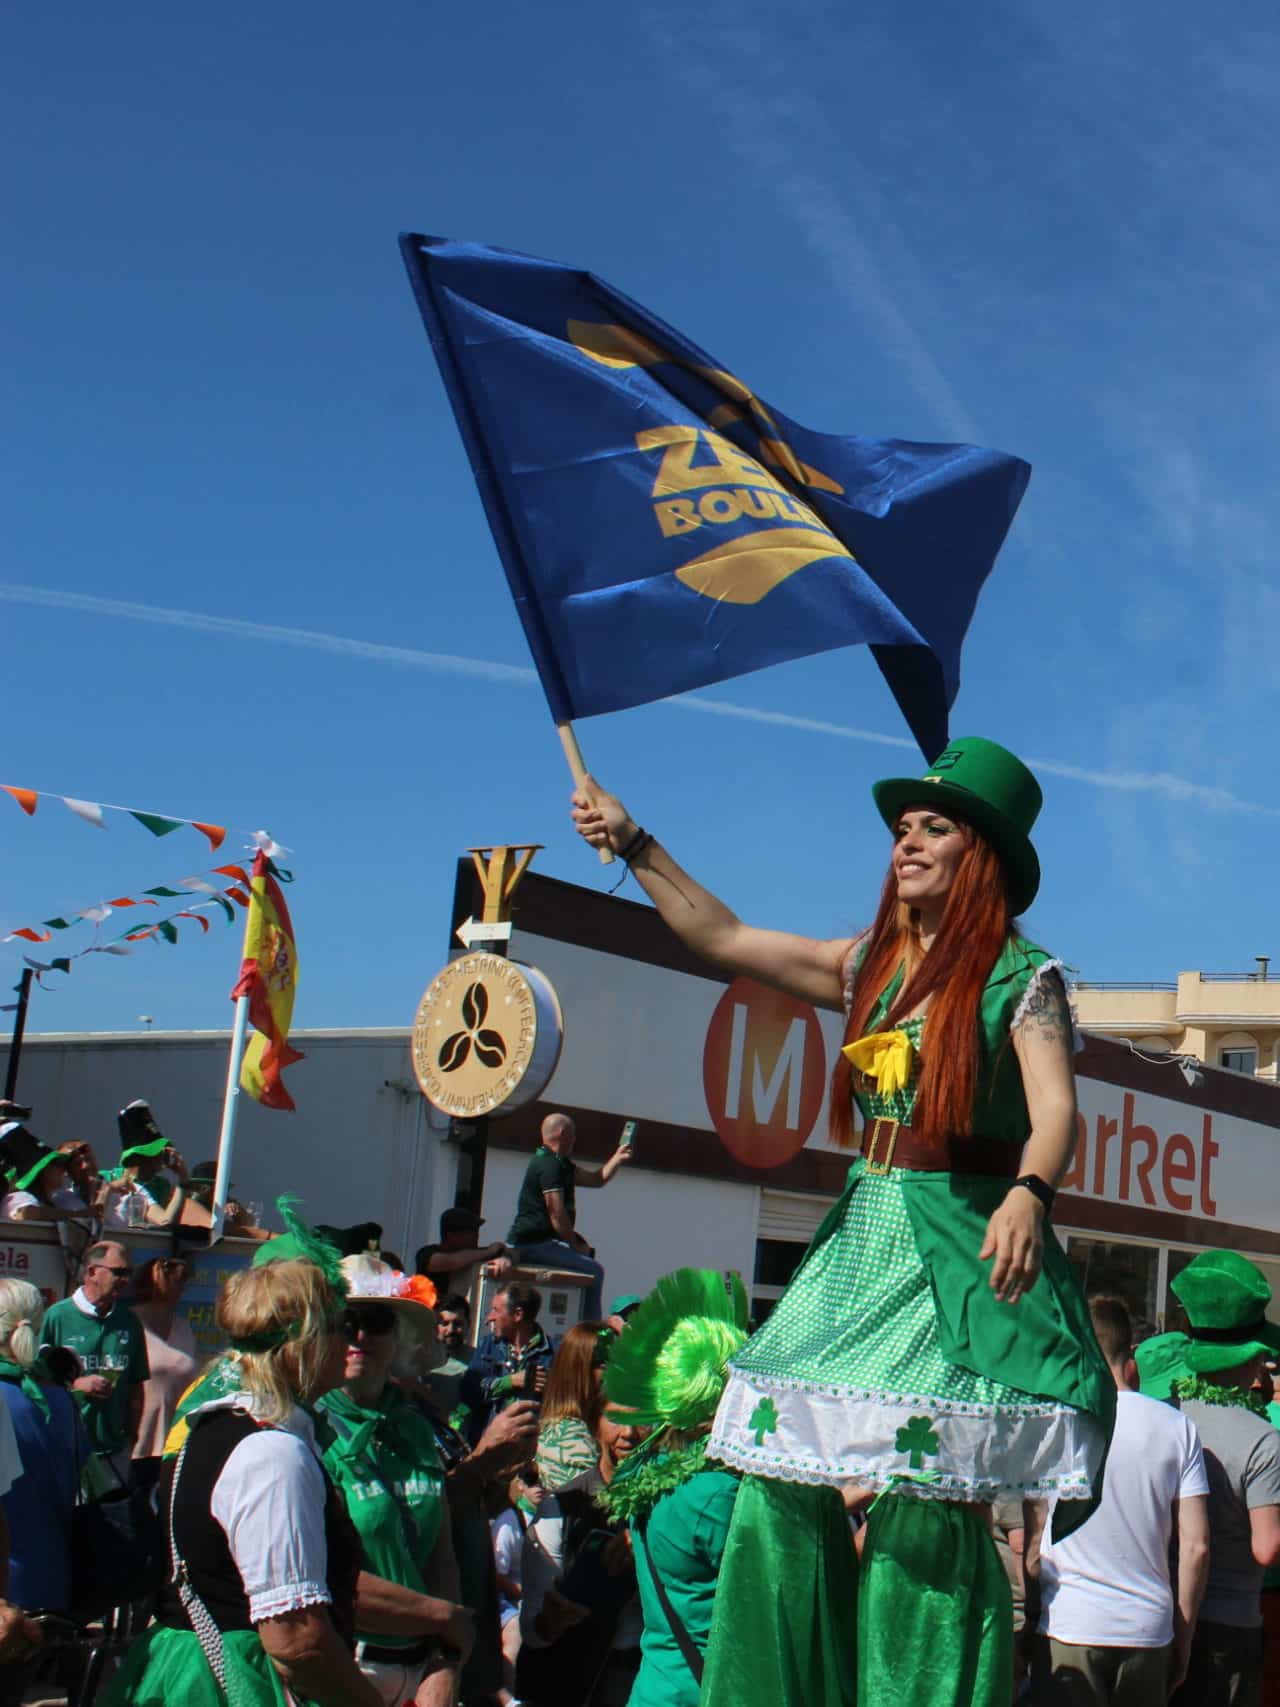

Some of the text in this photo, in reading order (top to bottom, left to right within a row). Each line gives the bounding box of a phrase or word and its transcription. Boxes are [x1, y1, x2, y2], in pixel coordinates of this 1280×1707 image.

[635, 425, 786, 498] ZE
[724, 1002, 1219, 1216] M arket
